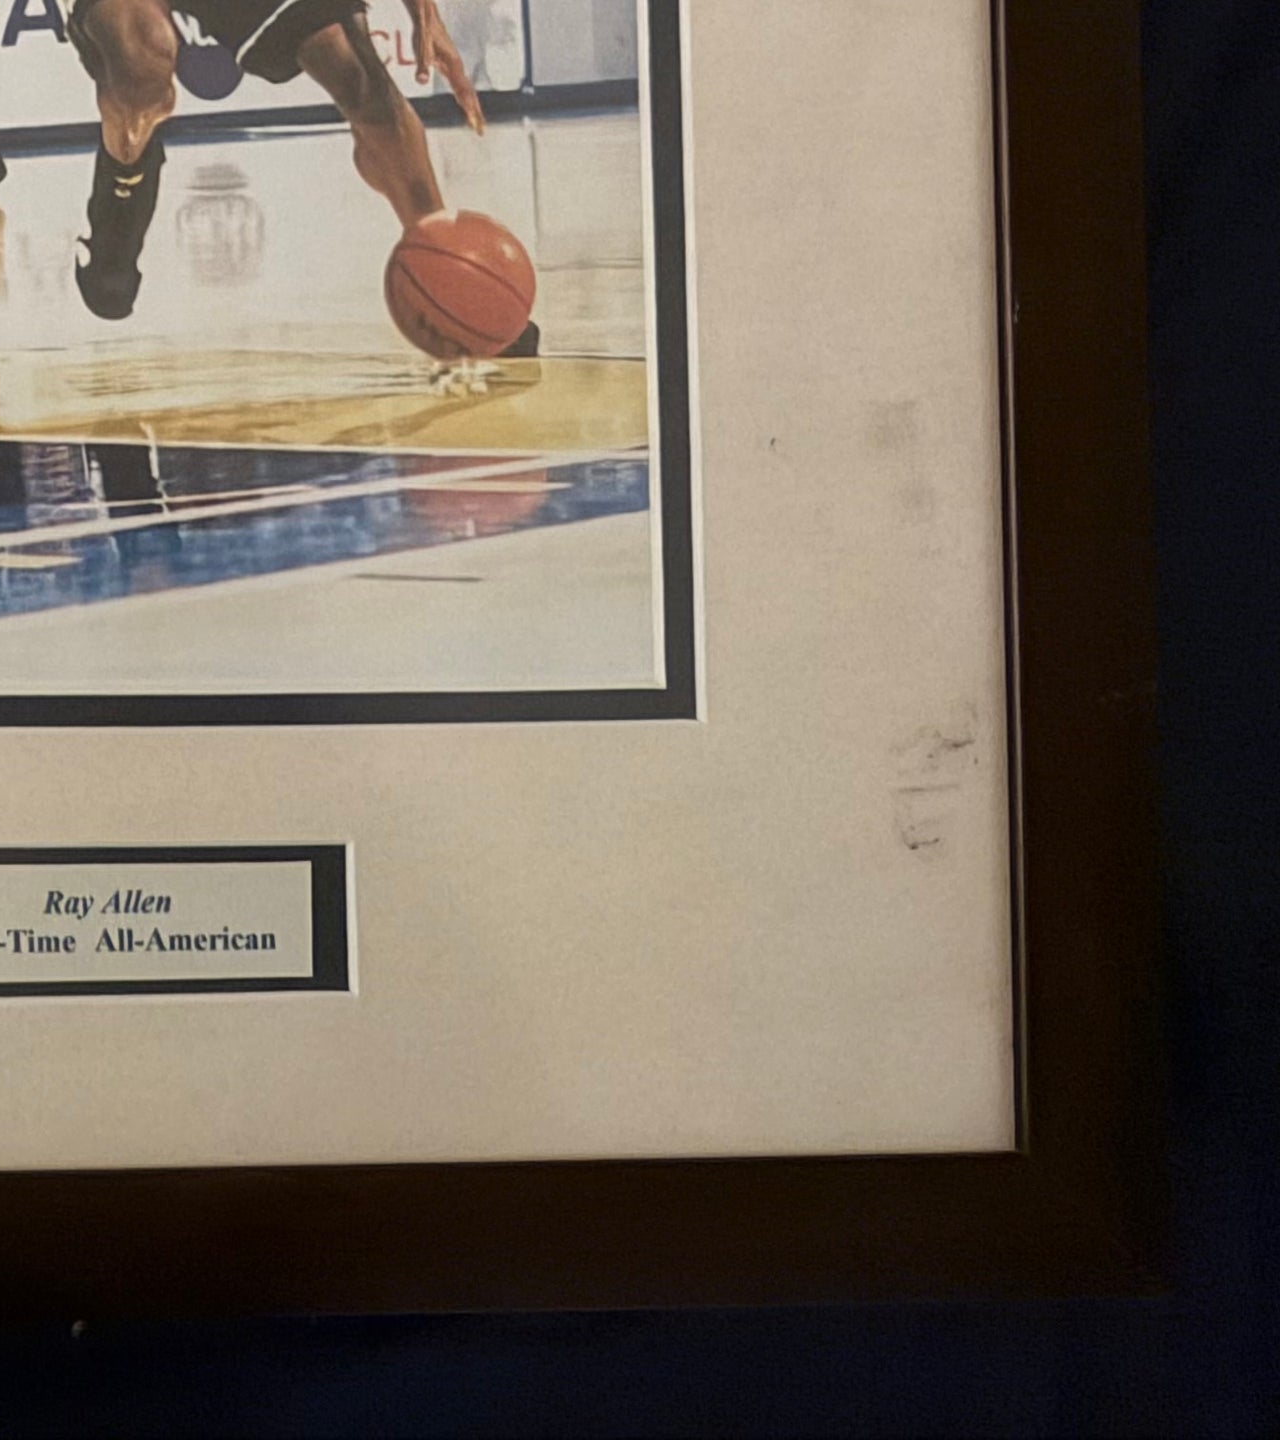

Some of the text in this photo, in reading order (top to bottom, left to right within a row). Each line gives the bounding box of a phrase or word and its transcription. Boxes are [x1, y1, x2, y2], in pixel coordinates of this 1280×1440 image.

[43, 888, 172, 920] Ray Allen
[94, 925, 277, 954] All-American
